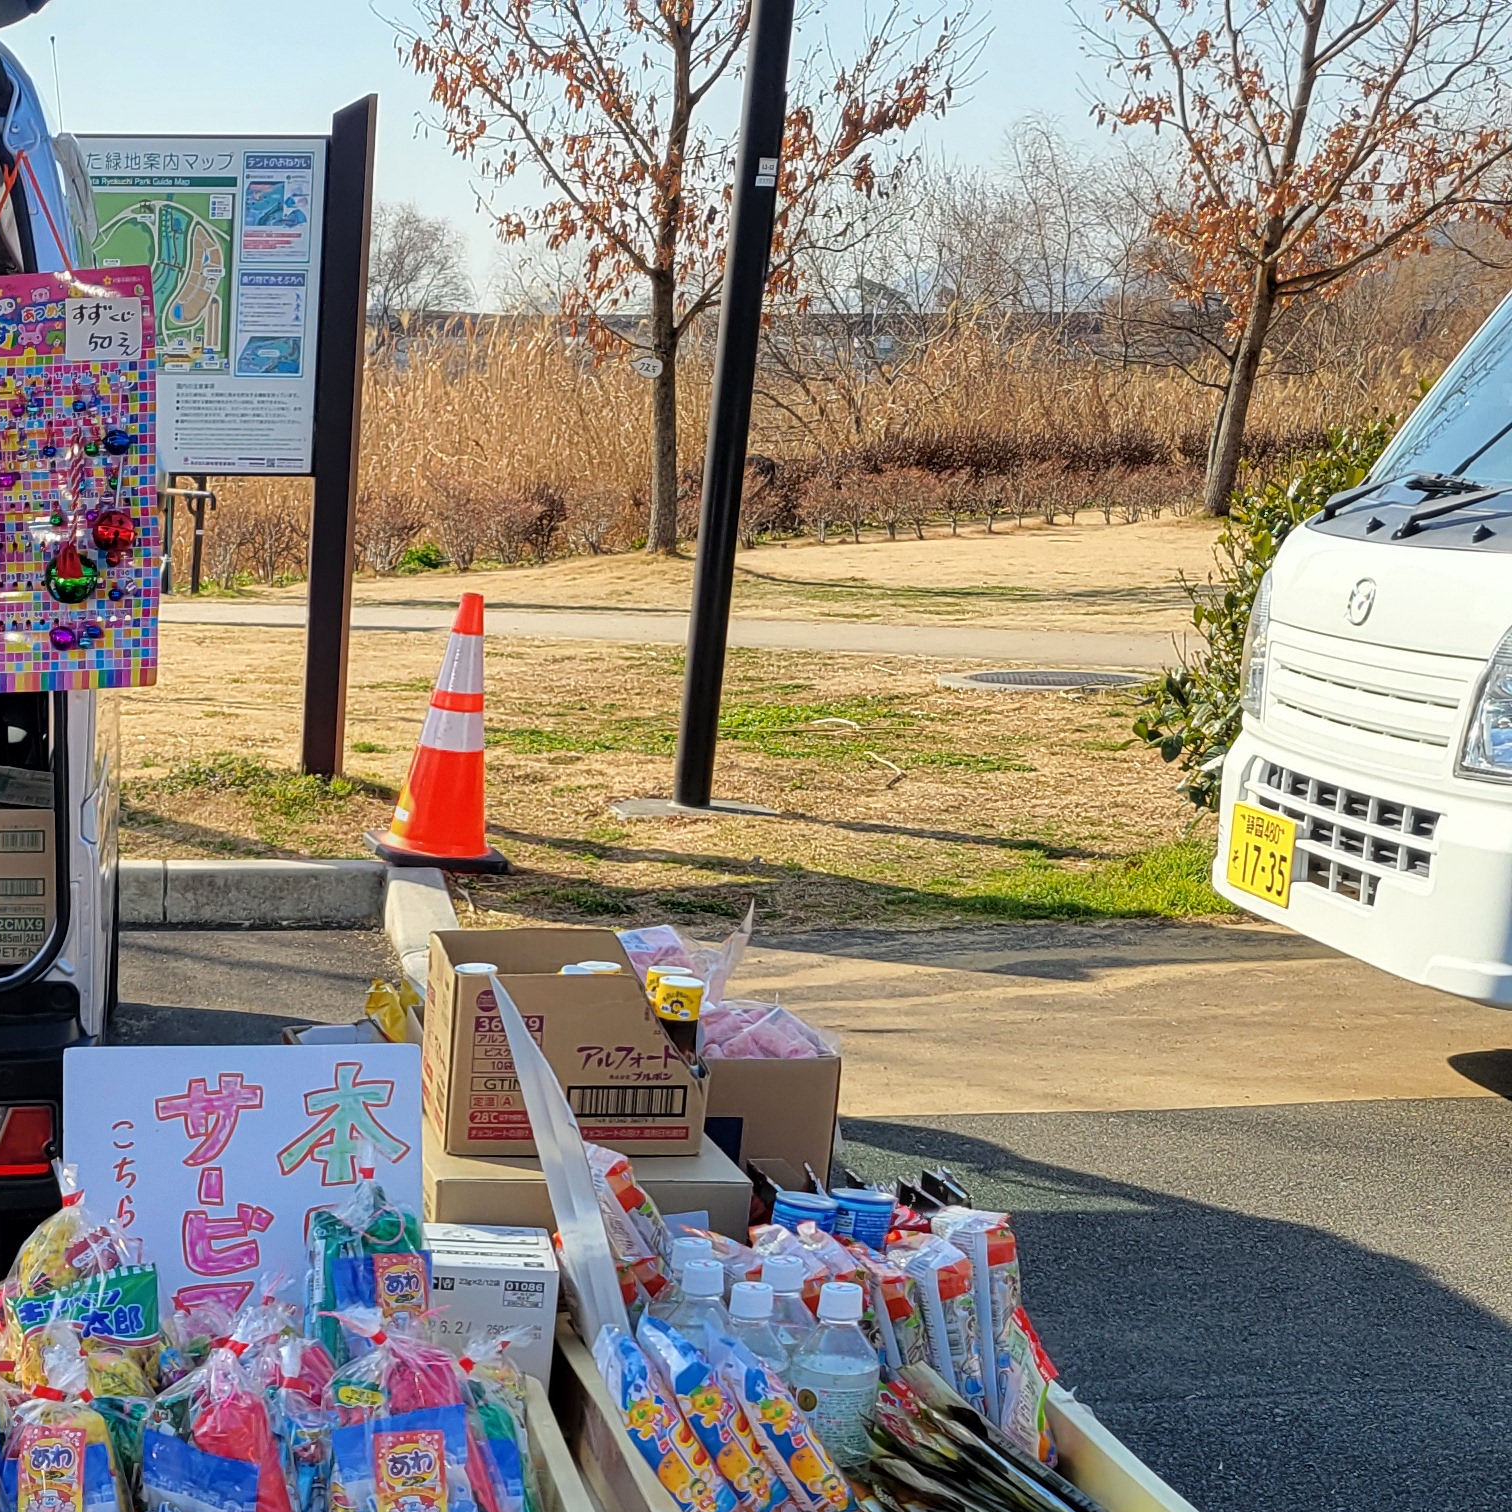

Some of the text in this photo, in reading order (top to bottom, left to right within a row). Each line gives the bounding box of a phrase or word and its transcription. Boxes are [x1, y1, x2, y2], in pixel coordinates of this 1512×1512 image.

[135, 177, 151, 185] Park
[152, 177, 172, 185] Guide
[173, 178, 191, 187] Map
[72, 303, 136, 326] すずくじ
[576, 1044, 683, 1071] アルフォート
[632, 1071, 674, 1081] ブルボン
[501, 1096, 512, 1107] A
[383, 1270, 422, 1295] あわ
[505, 1282, 544, 1292] 01086
[79, 1303, 145, 1338] 太郎
[29, 1444, 75, 1471] あわ
[387, 1449, 436, 1478] あわ
